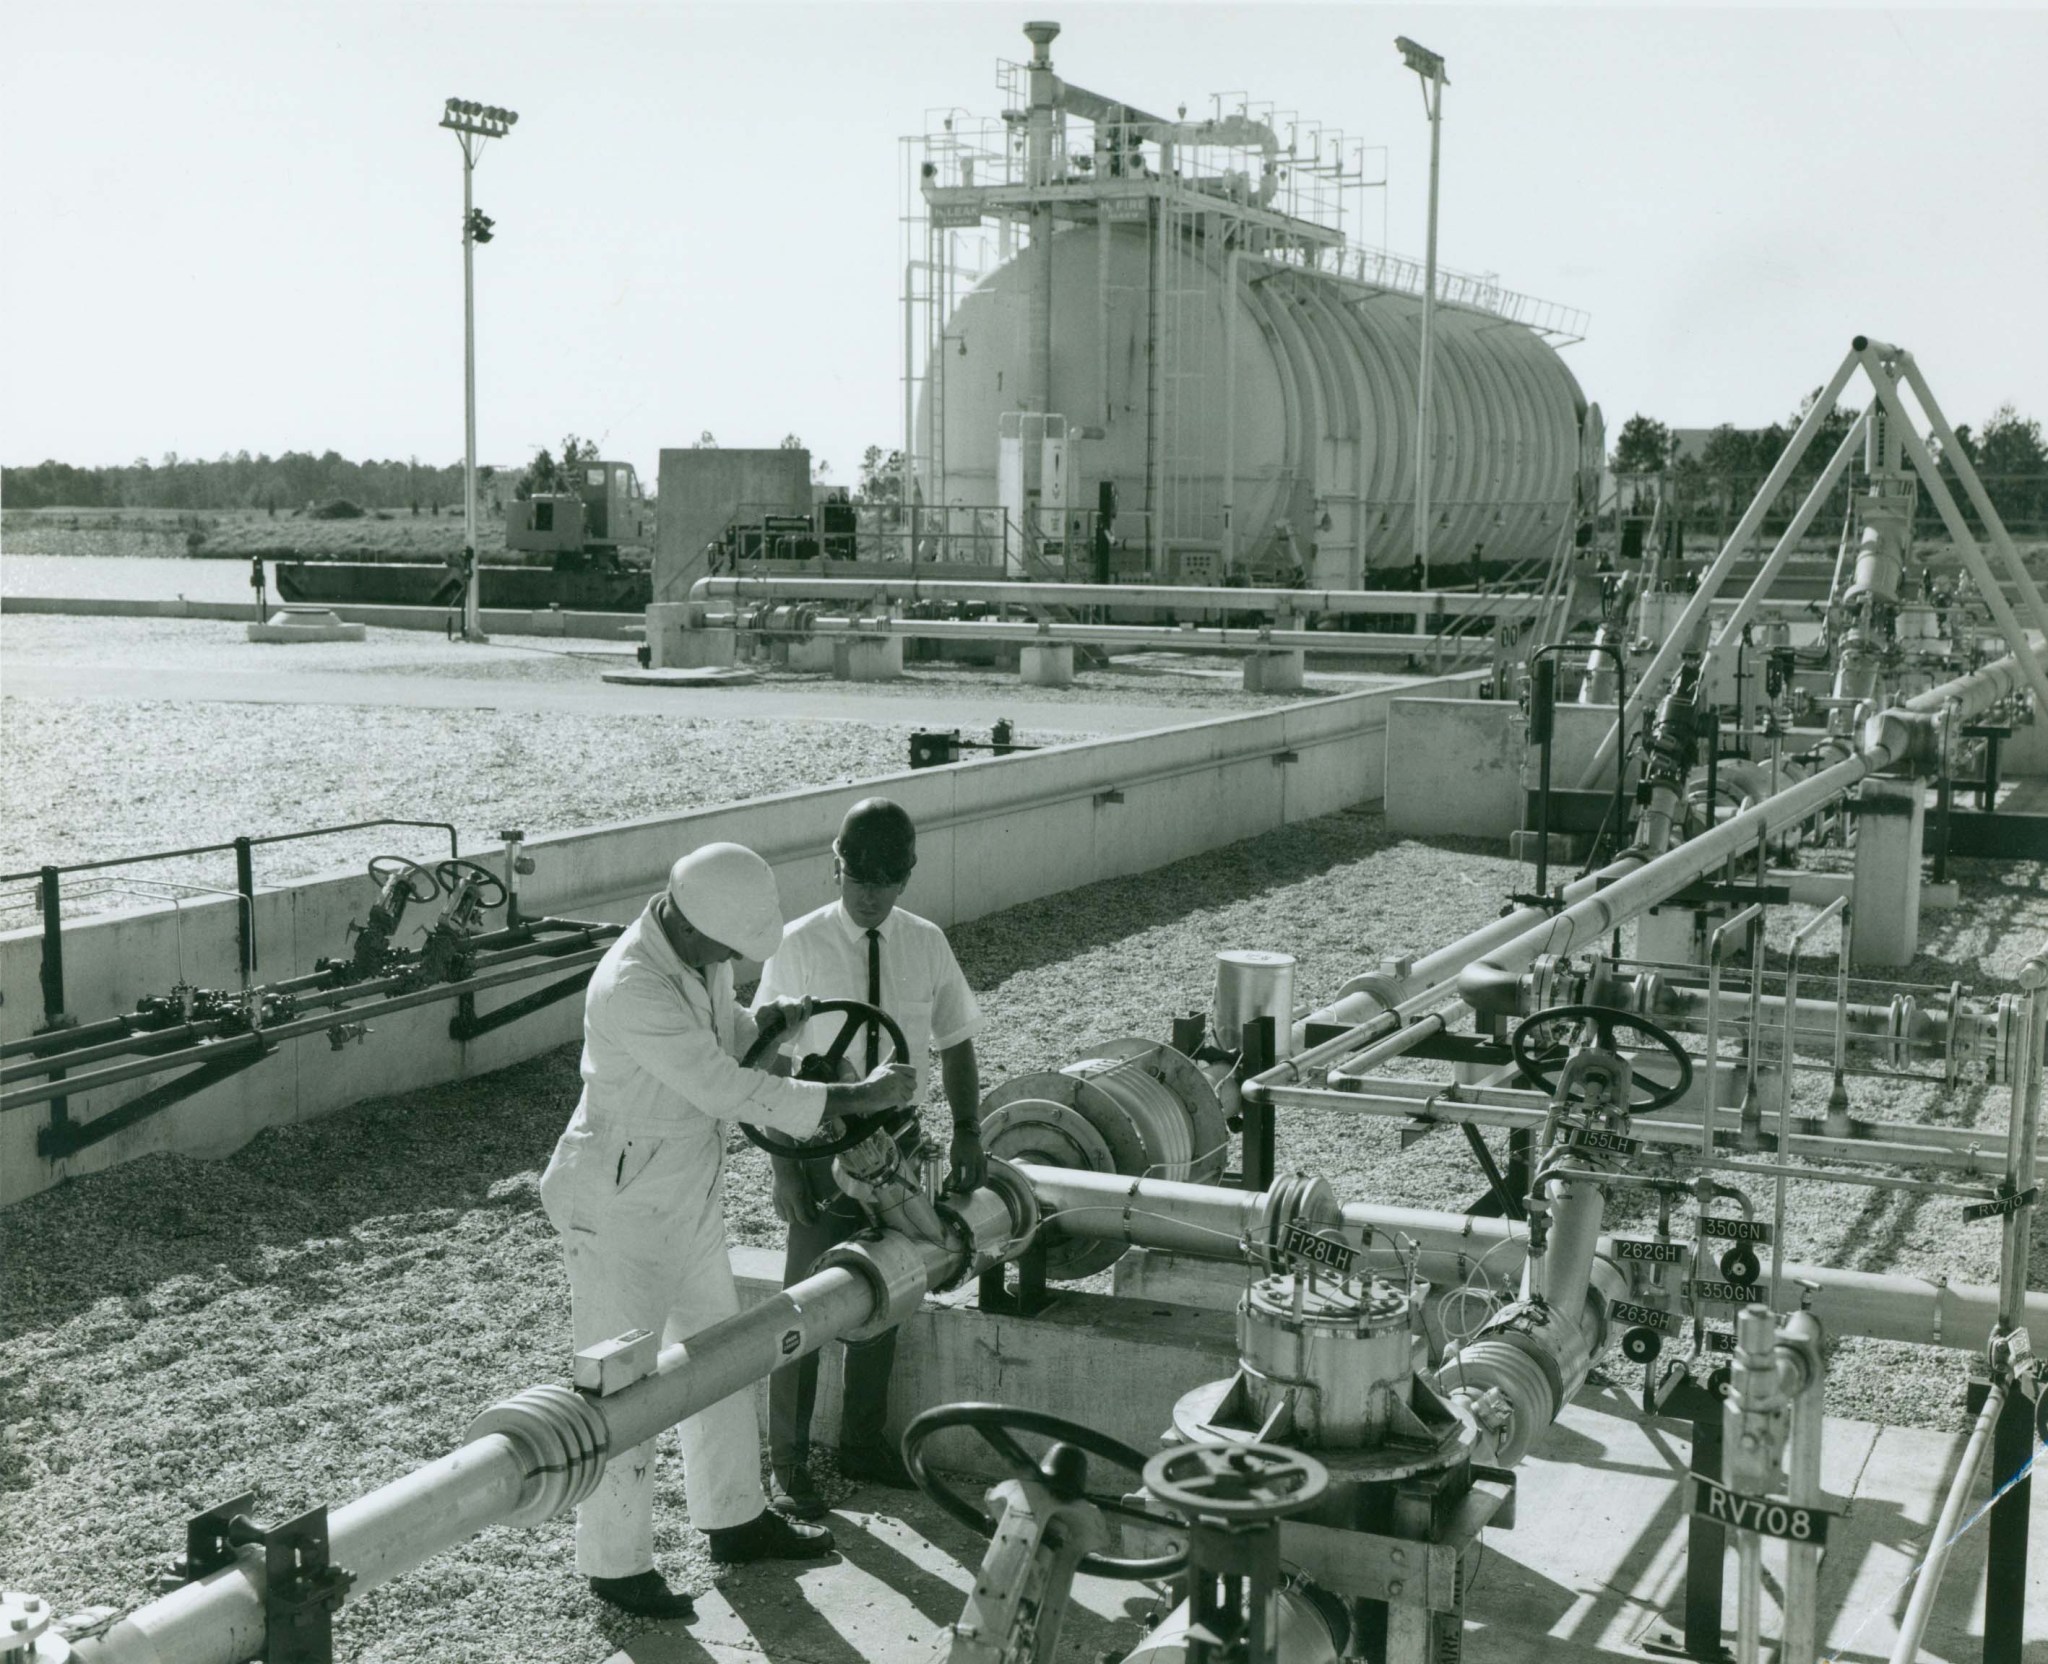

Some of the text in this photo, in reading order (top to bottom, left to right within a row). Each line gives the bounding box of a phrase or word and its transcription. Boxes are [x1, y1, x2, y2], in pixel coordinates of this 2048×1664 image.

[1583, 1131, 1628, 1152] 155LH
[1979, 1195, 2023, 1217] RV710
[1707, 1218, 1761, 1240] 350GN
[1288, 1230, 1349, 1270] F128LH
[1622, 1242, 1676, 1261] 262GH
[1702, 1281, 1757, 1301] 350GN
[1616, 1303, 1670, 1330] 263GH
[1709, 1486, 1811, 1540] RV708
